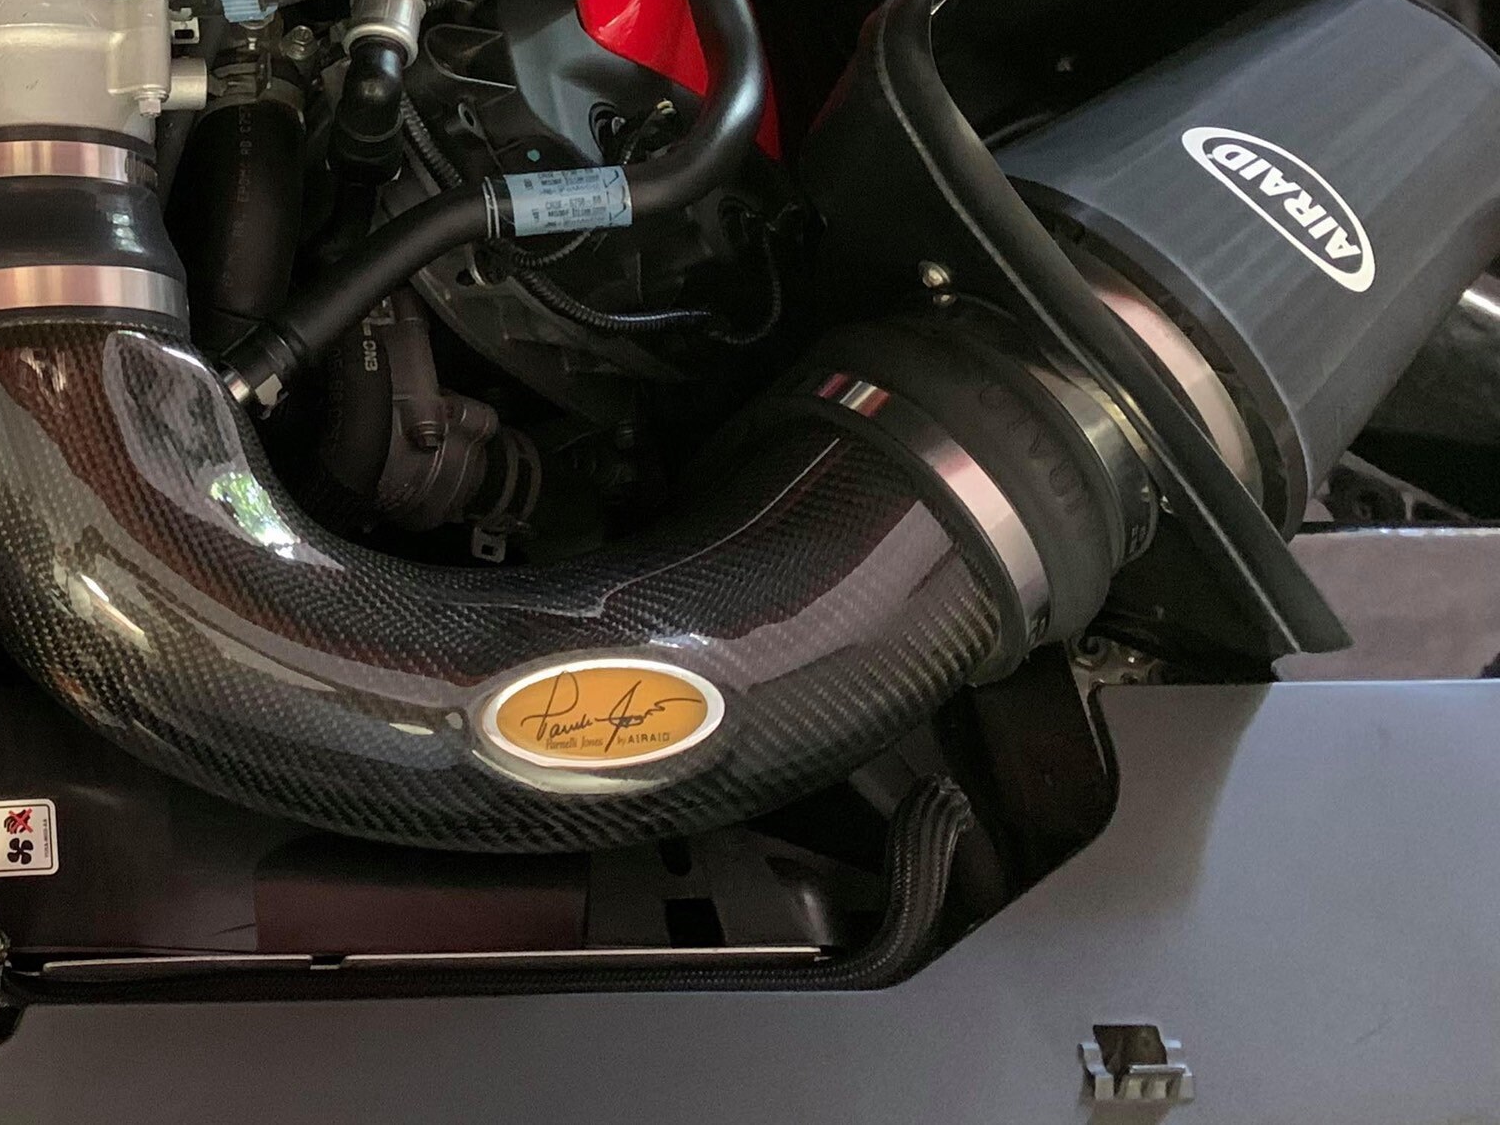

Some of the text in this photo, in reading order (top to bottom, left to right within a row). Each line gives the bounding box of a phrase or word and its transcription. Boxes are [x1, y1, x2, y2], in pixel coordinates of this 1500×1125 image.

[1211, 143, 1362, 260] AIRAID
[580, 736, 604, 750] Jones
[627, 732, 671, 744] AIRAID
